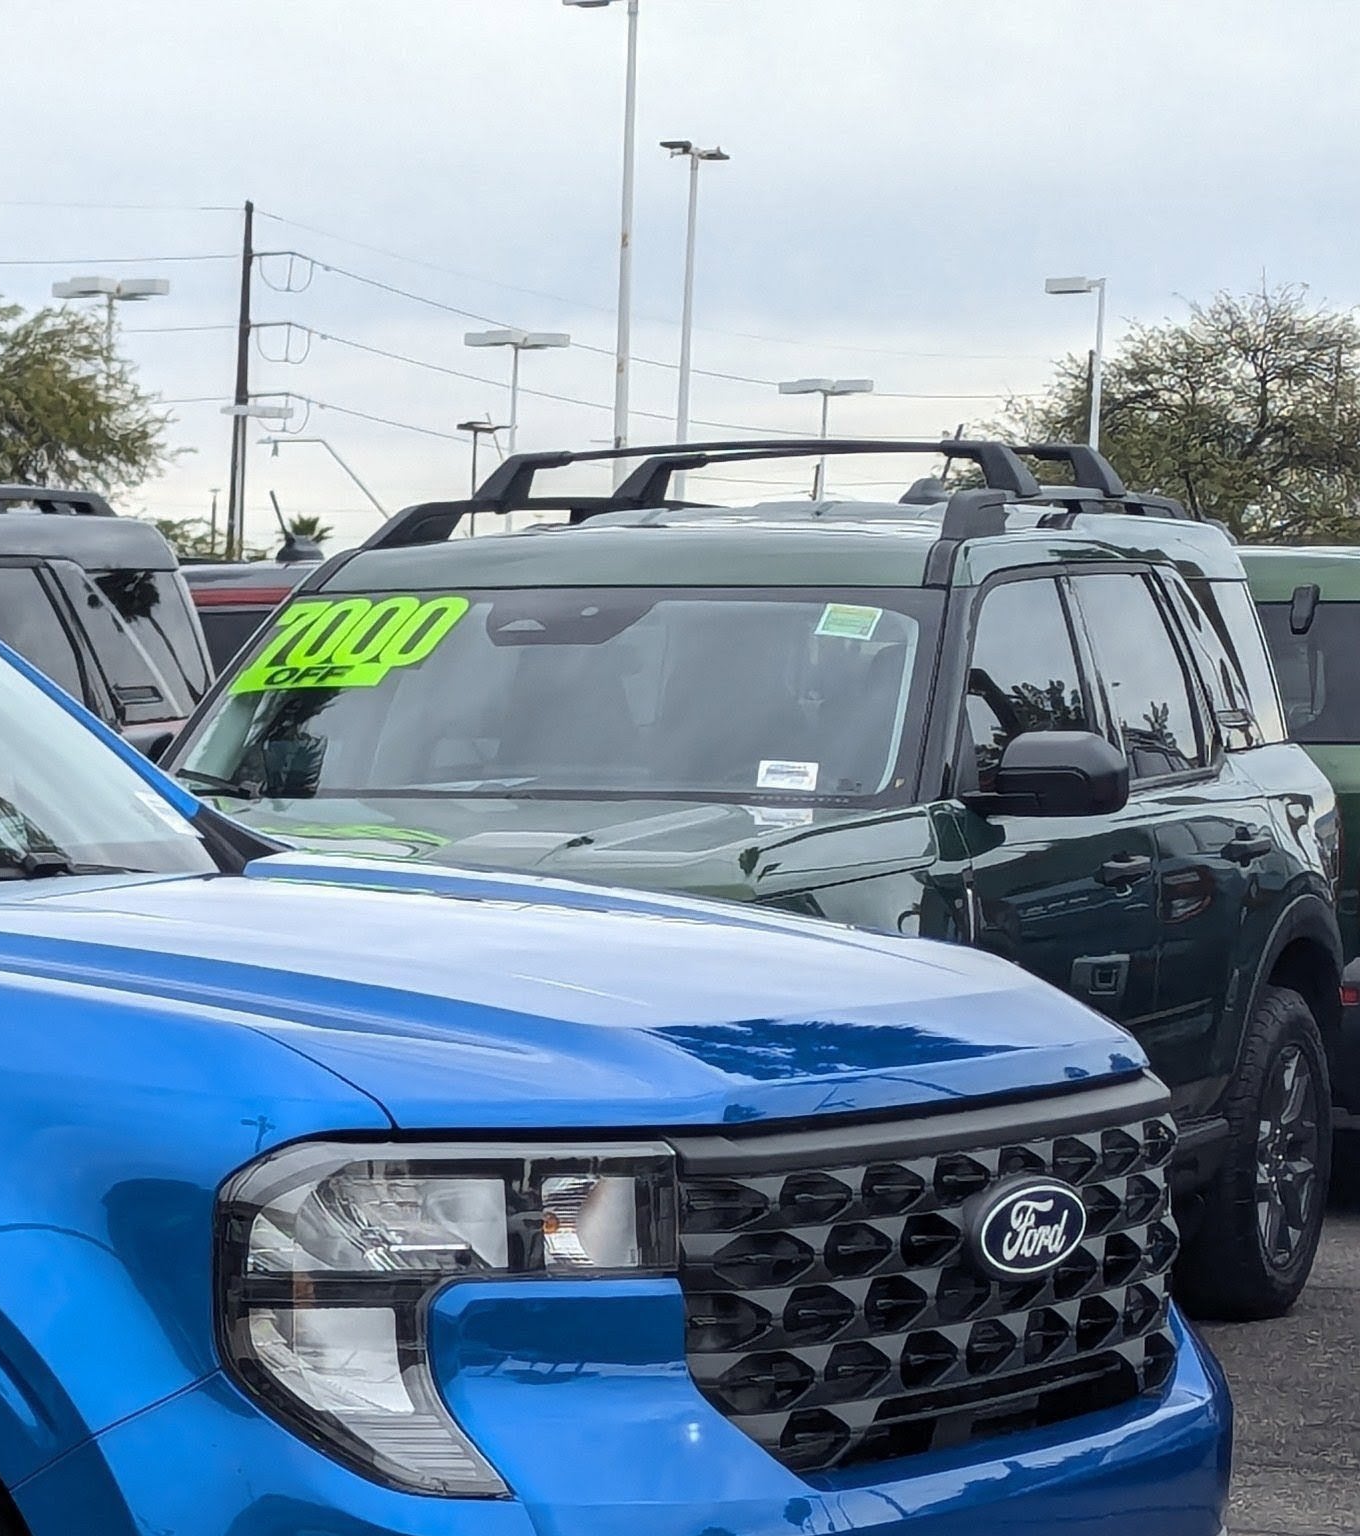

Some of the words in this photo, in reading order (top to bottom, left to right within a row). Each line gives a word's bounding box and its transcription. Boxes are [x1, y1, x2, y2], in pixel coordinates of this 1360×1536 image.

[252, 596, 470, 668] 7000
[263, 664, 355, 686] OFF
[1002, 1199, 1069, 1261] Ford
